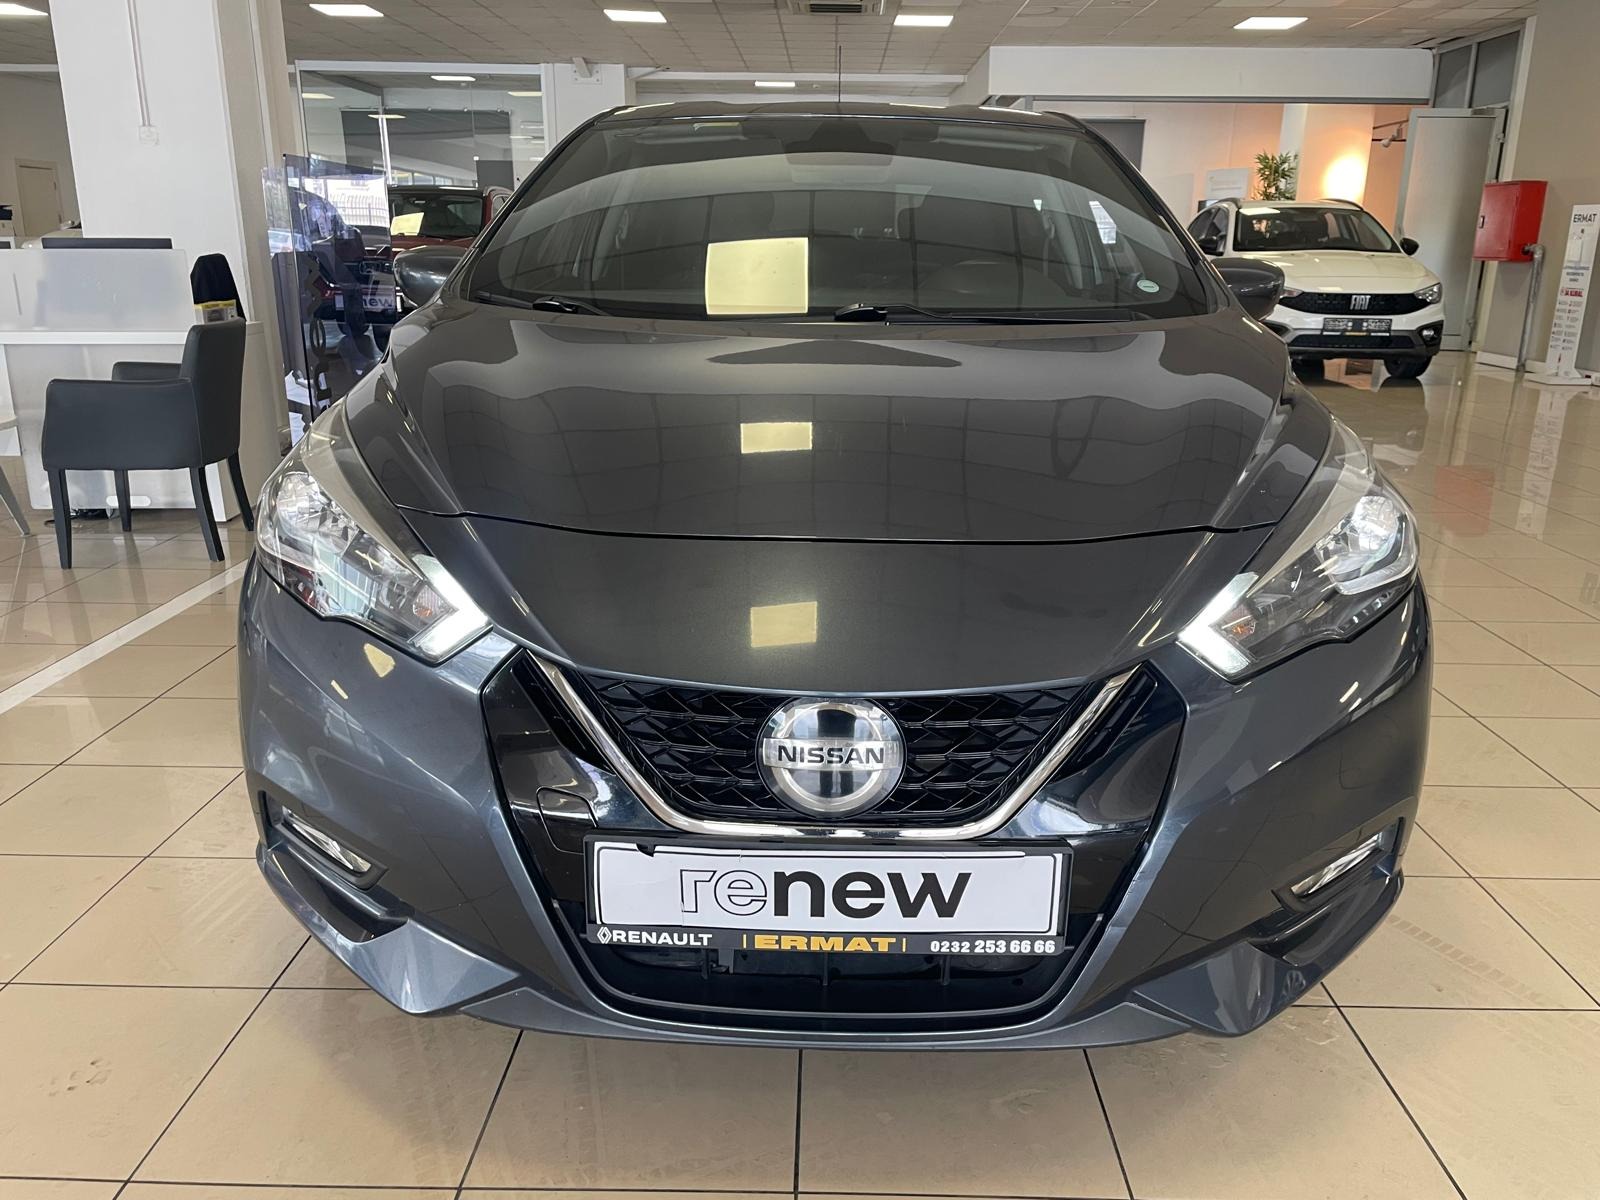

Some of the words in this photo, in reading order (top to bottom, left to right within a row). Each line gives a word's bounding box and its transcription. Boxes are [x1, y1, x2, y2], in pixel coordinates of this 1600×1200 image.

[1573, 213, 1598, 223] ERMAT
[1350, 295, 1371, 310] FIAT
[777, 745, 885, 765] NISSAN
[680, 869, 972, 919] renew
[612, 929, 713, 946] RENAULT
[754, 934, 897, 952] ERMAT
[930, 940, 970, 952] 0232
[974, 939, 1006, 953] 253
[1009, 940, 1031, 953] 66
[1034, 940, 1056, 953] 66
